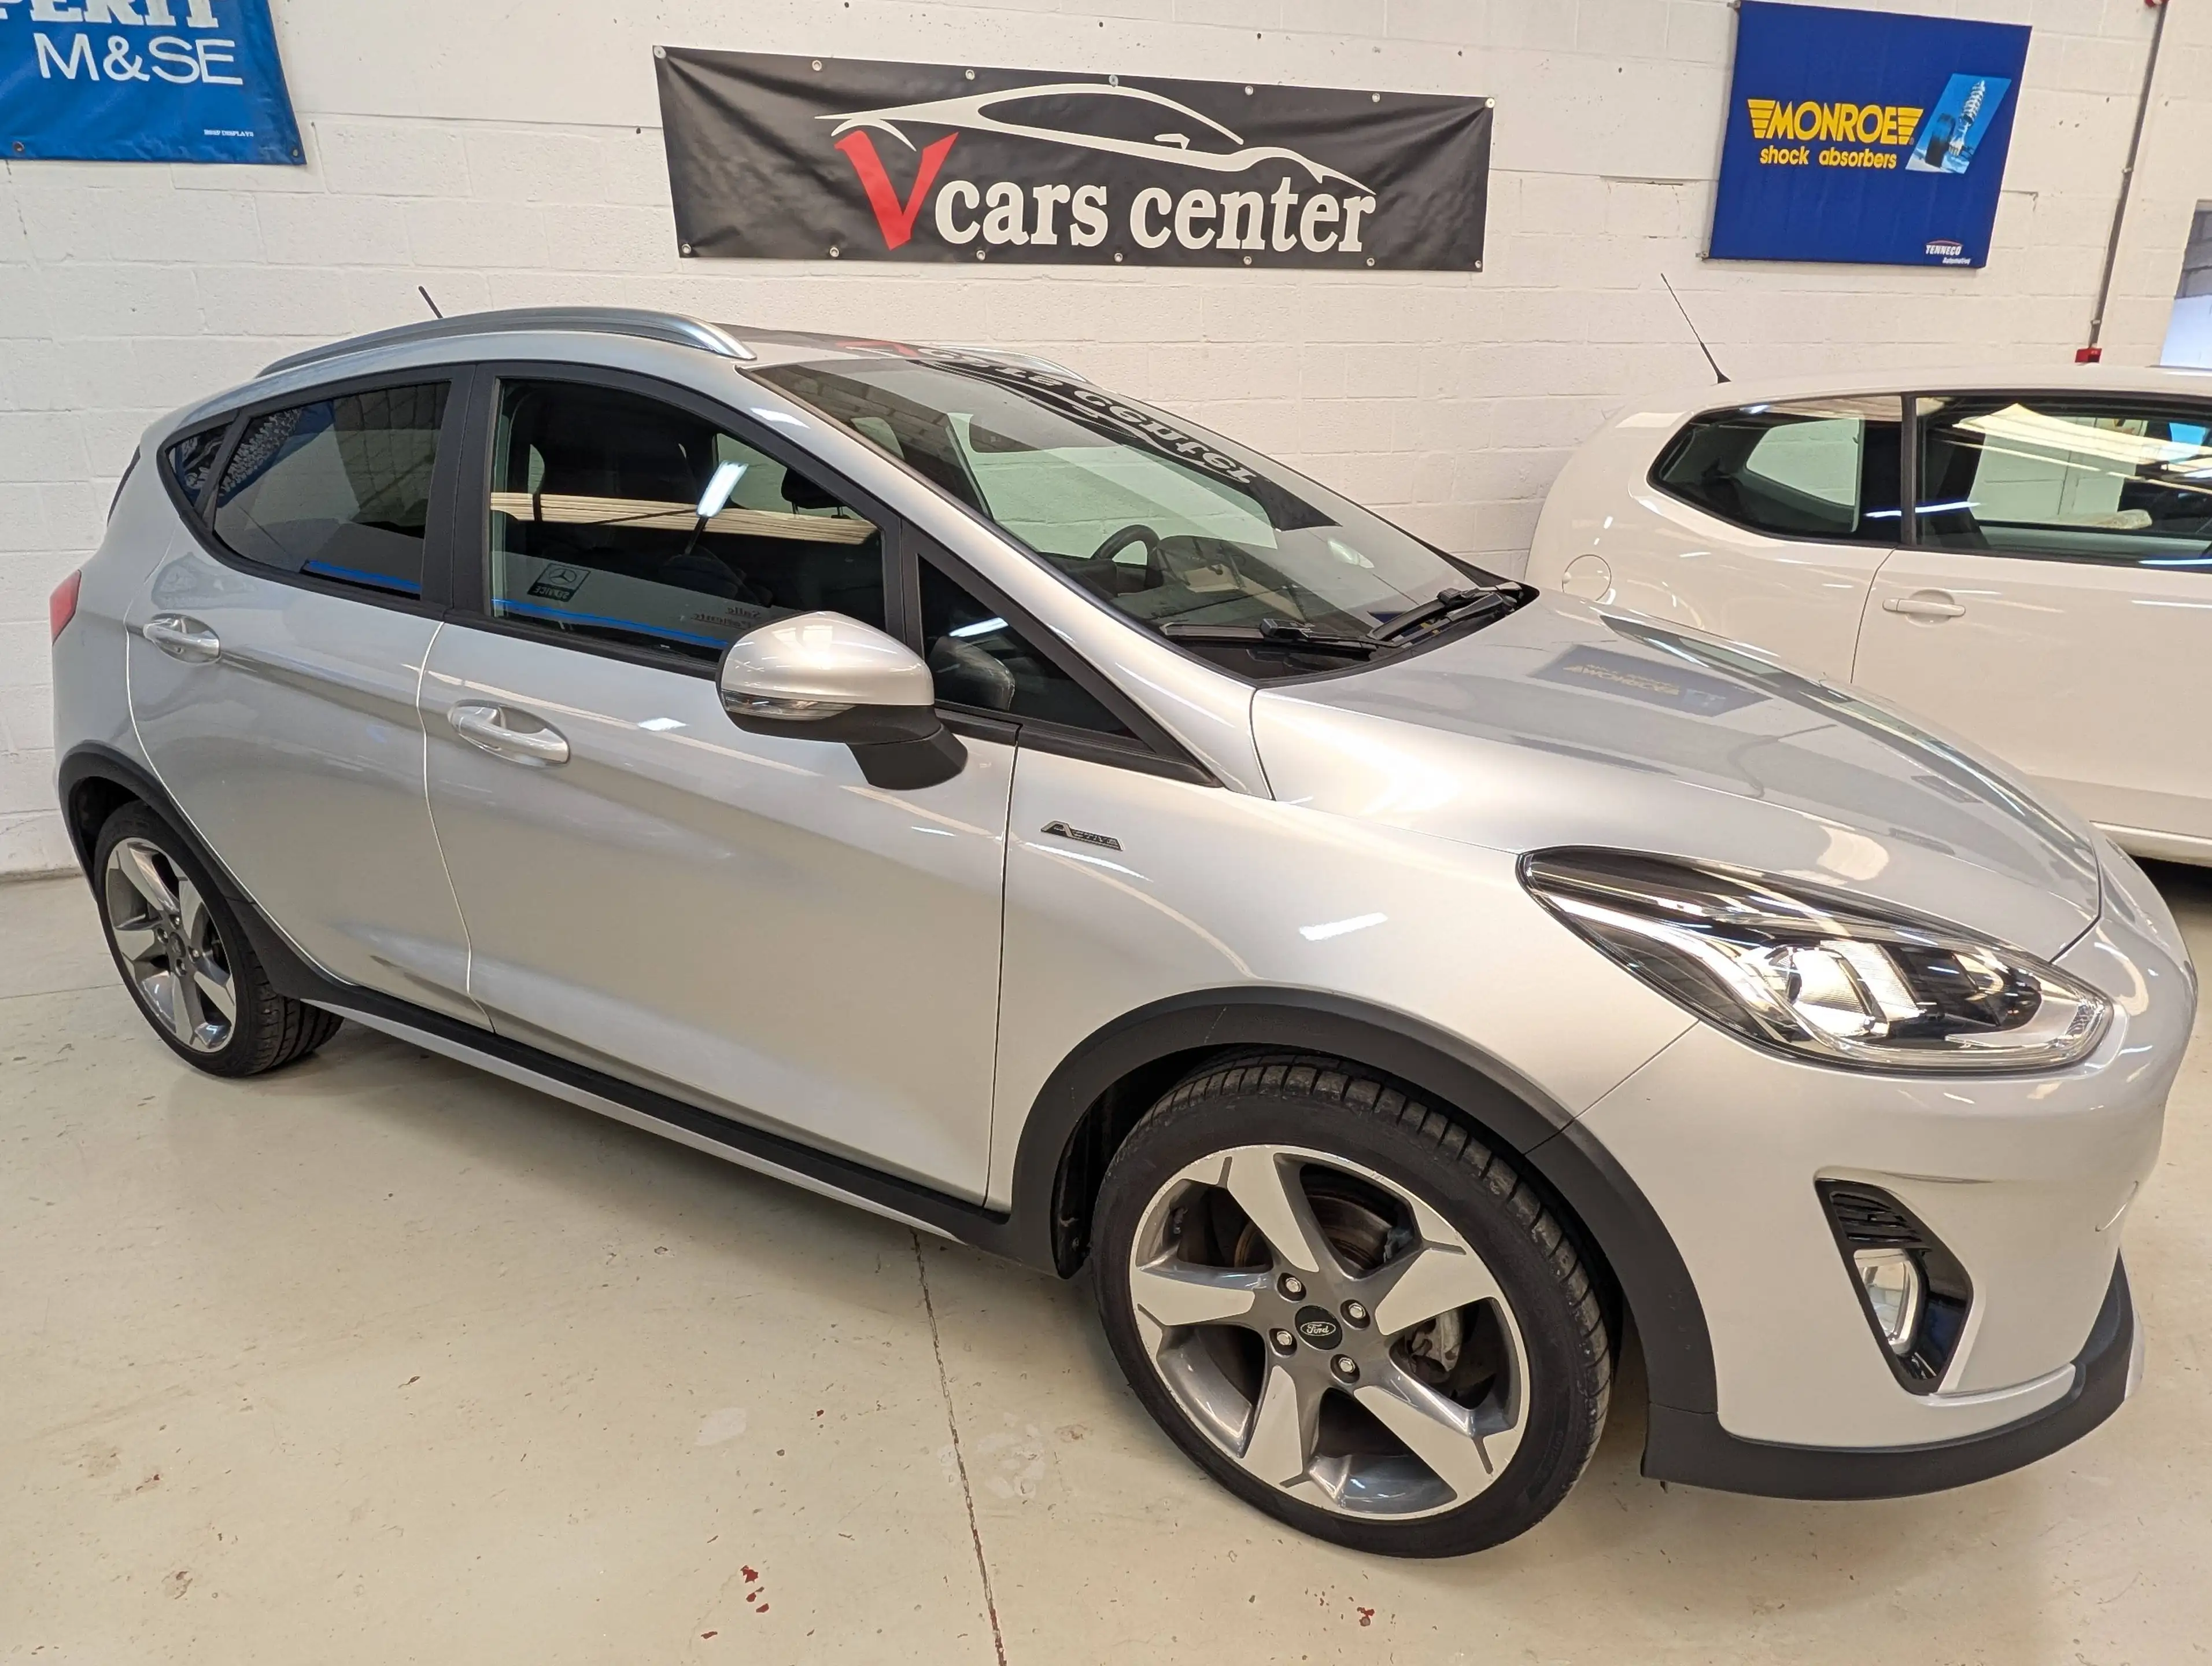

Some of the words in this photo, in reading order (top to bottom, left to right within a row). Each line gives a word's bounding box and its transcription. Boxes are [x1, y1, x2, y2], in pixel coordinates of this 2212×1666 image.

[34, 33, 243, 85] M&SE
[1766, 101, 1898, 144] MONROE
[1760, 145, 1810, 165] shock
[1819, 146, 1897, 169] absorbers
[1129, 176, 1376, 253] center
[1926, 245, 1963, 256] TENNECO
[1306, 1324, 1329, 1334] Ford
